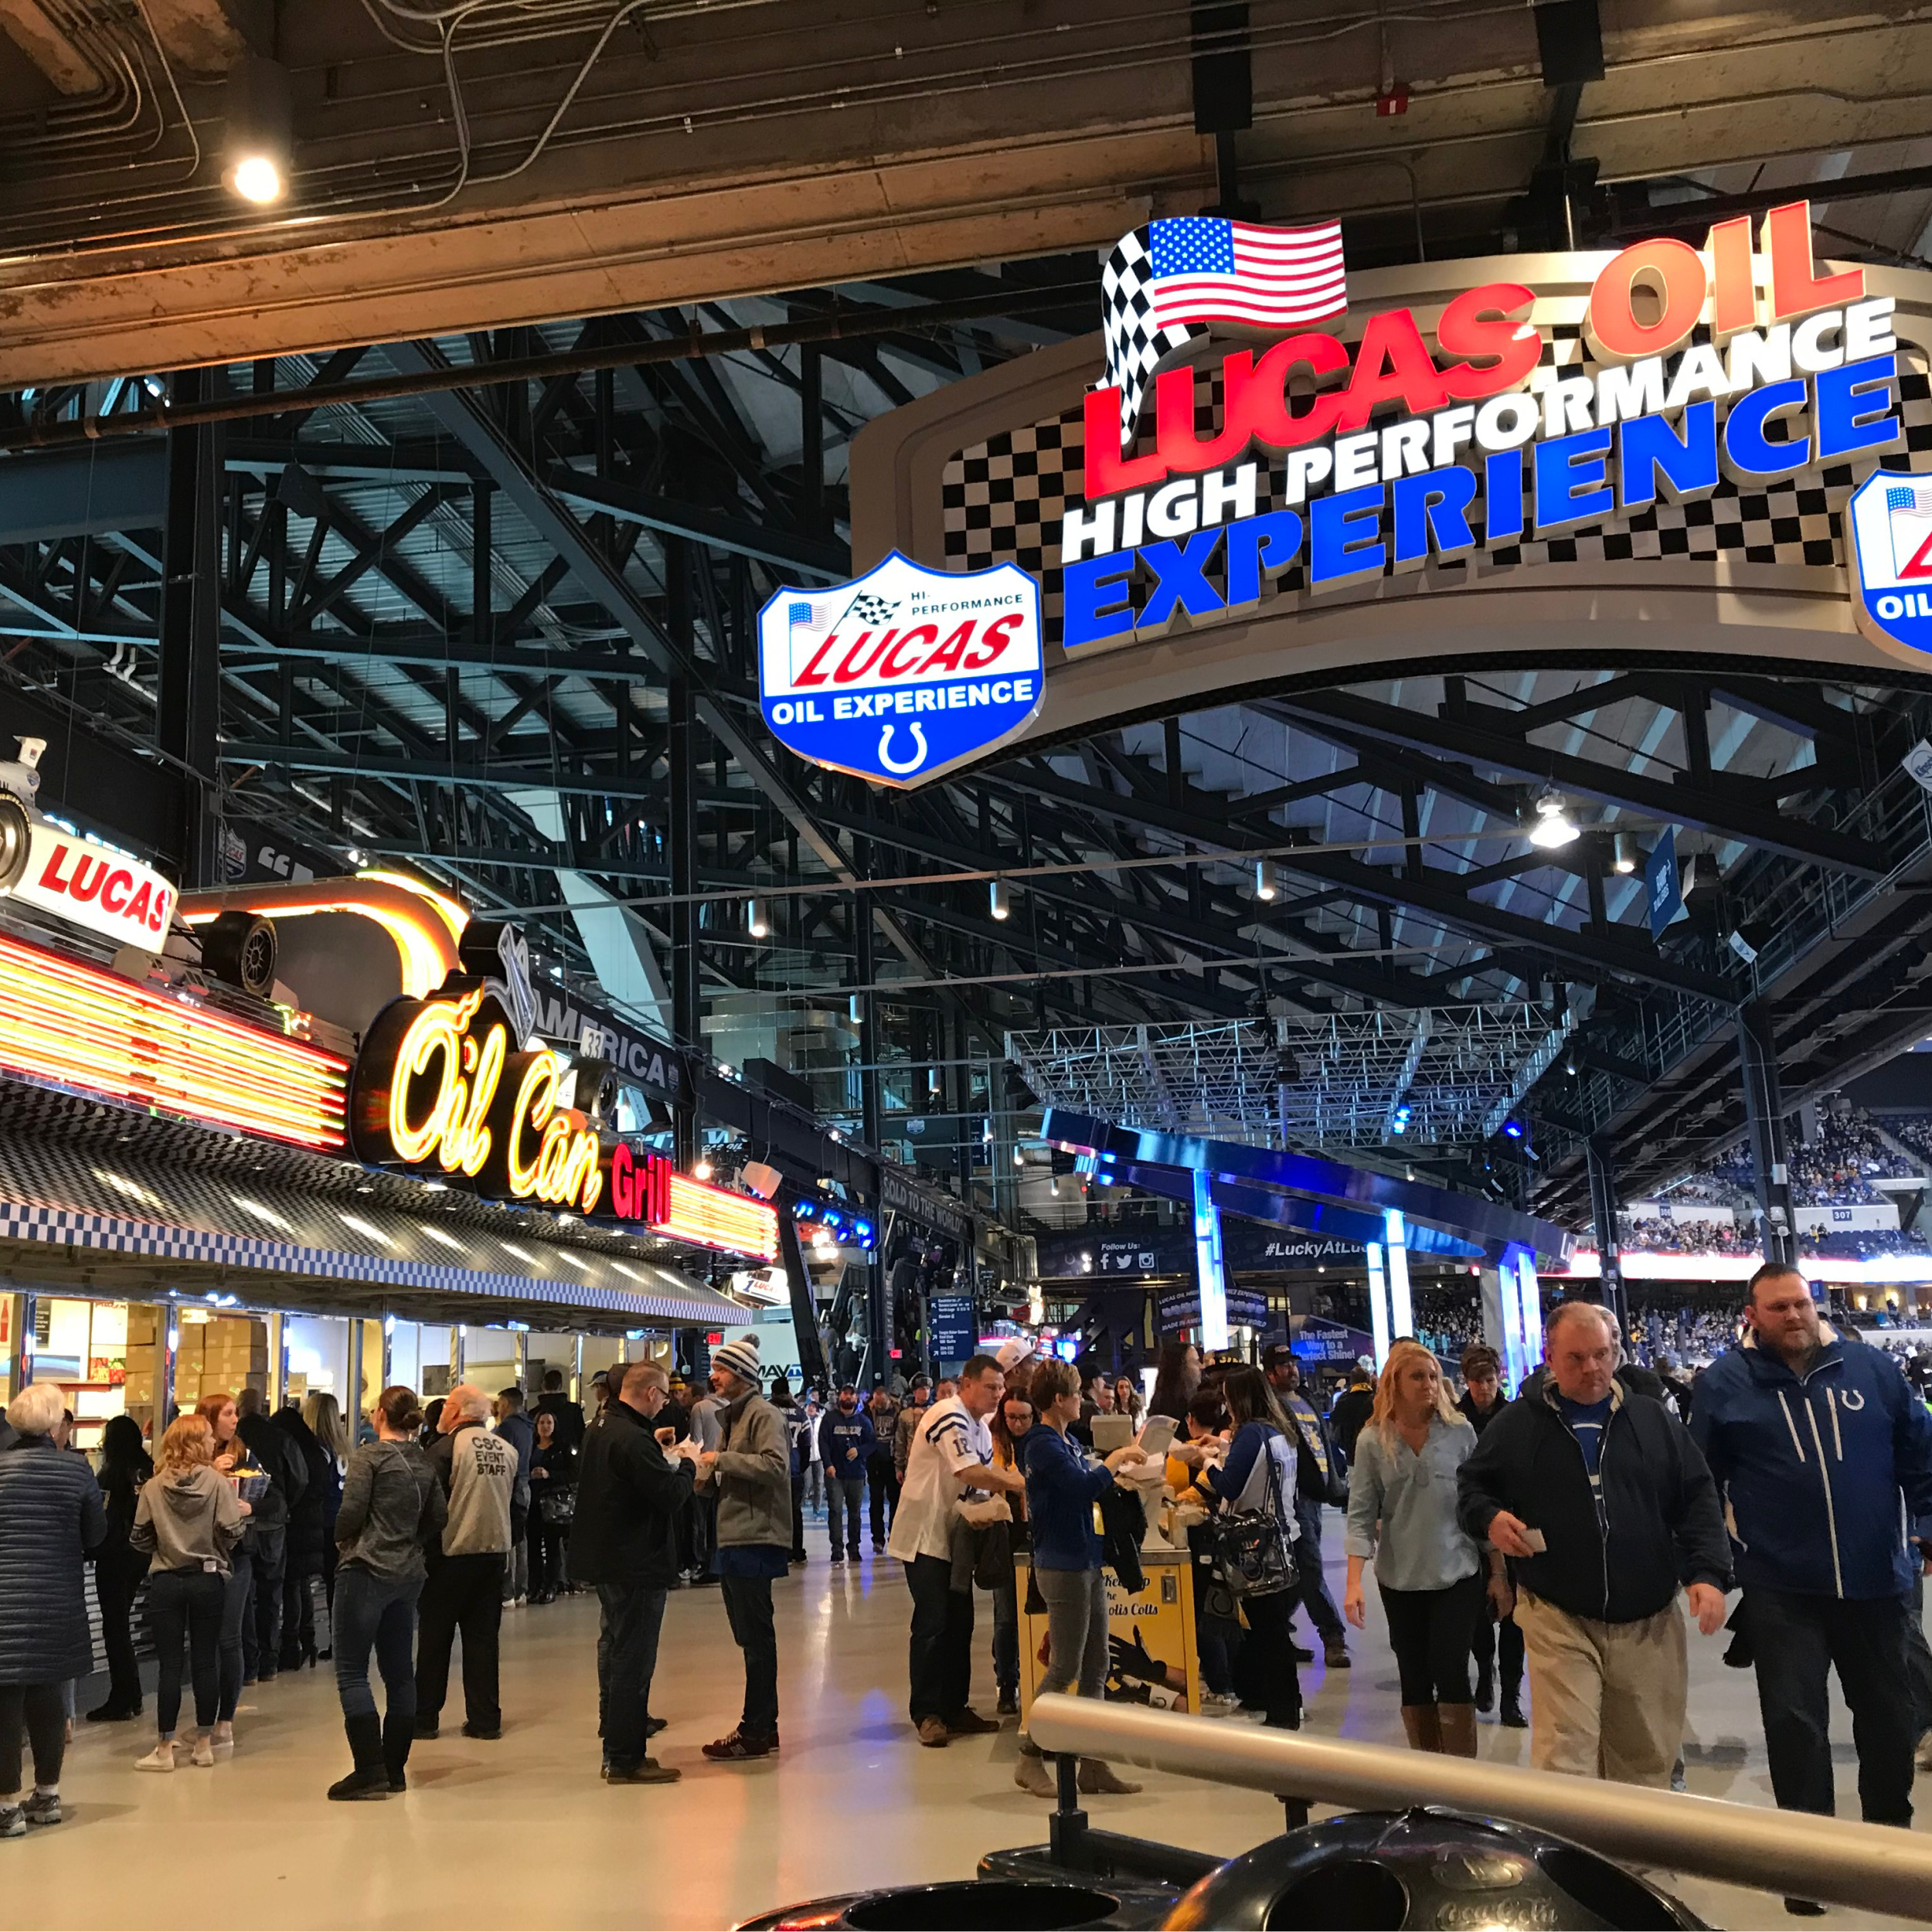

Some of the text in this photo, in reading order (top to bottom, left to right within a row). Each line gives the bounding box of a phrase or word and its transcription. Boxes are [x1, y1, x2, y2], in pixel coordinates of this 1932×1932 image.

[1084, 199, 1865, 500] LUCAS OIL
[1061, 297, 1896, 563] HIGH PERFORMANCE
[1063, 354, 1900, 648] EXPERIENCE
[911, 592, 930, 601] HI-
[911, 594, 1024, 616] PERFORMANCE
[1876, 593, 1932, 620] OIL
[790, 613, 1025, 688] LUCAS
[771, 679, 1033, 725] OIL EXPERIENCE
[39, 845, 172, 932] LUCAS
[389, 988, 672, 1226] Oil Can Grill
[883, 1176, 907, 1206] SOLD
[907, 1191, 920, 1213] TO
[920, 1196, 936, 1221] THE
[1834, 1211, 1852, 1219] 307
[743, 1280, 774, 1292] 1 LUCA
[1299, 1329, 1349, 1340] The Fastest
[1306, 1340, 1343, 1350] Way to a
[1328, 1349, 1355, 1359] Shine!
[471, 1437, 503, 1451] CSC
[475, 1451, 505, 1464] EVENT
[477, 1464, 506, 1476] STAFF
[1131, 1603, 1158, 1615] Colts
